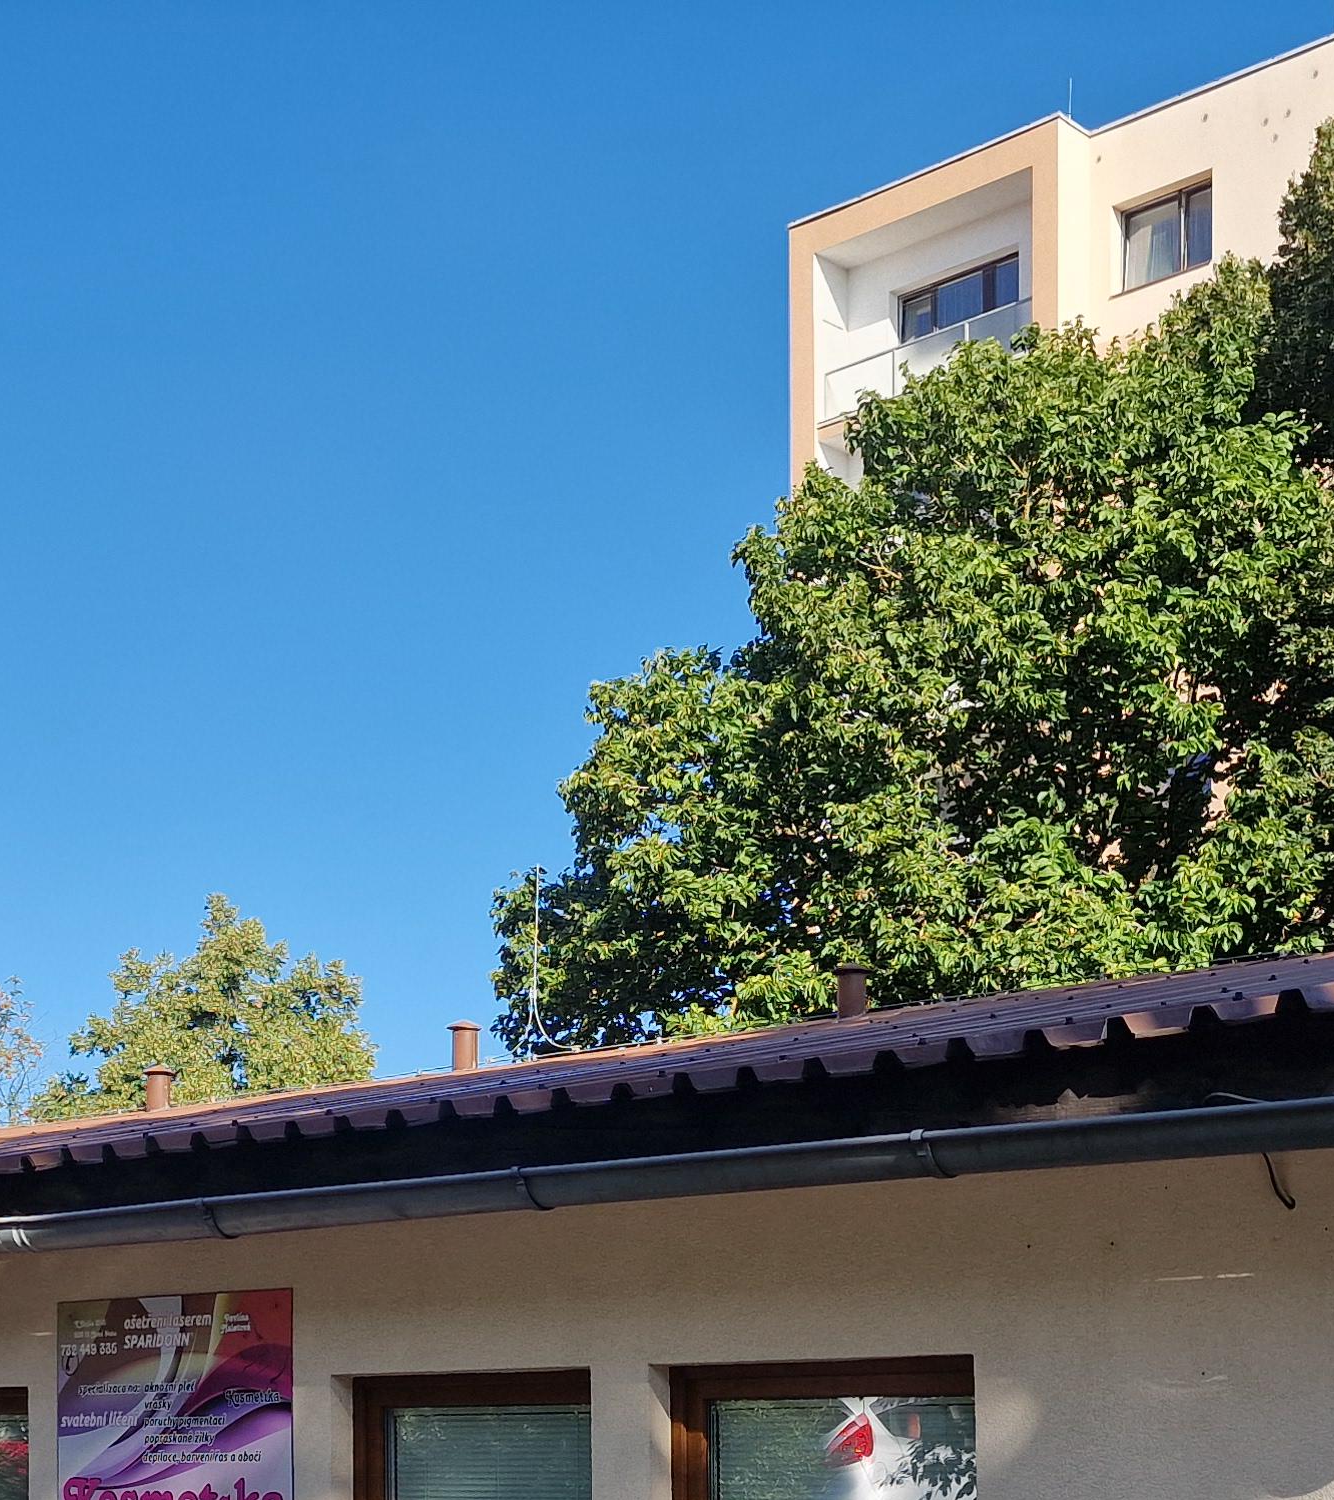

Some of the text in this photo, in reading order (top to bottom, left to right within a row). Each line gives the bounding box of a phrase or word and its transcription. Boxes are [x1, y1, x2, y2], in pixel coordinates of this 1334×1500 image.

[168, 1313, 212, 1329] laserem
[225, 1389, 280, 1408] Kosmetika
[60, 1410, 107, 1427] svatební
[144, 1415, 177, 1428] poruchy
